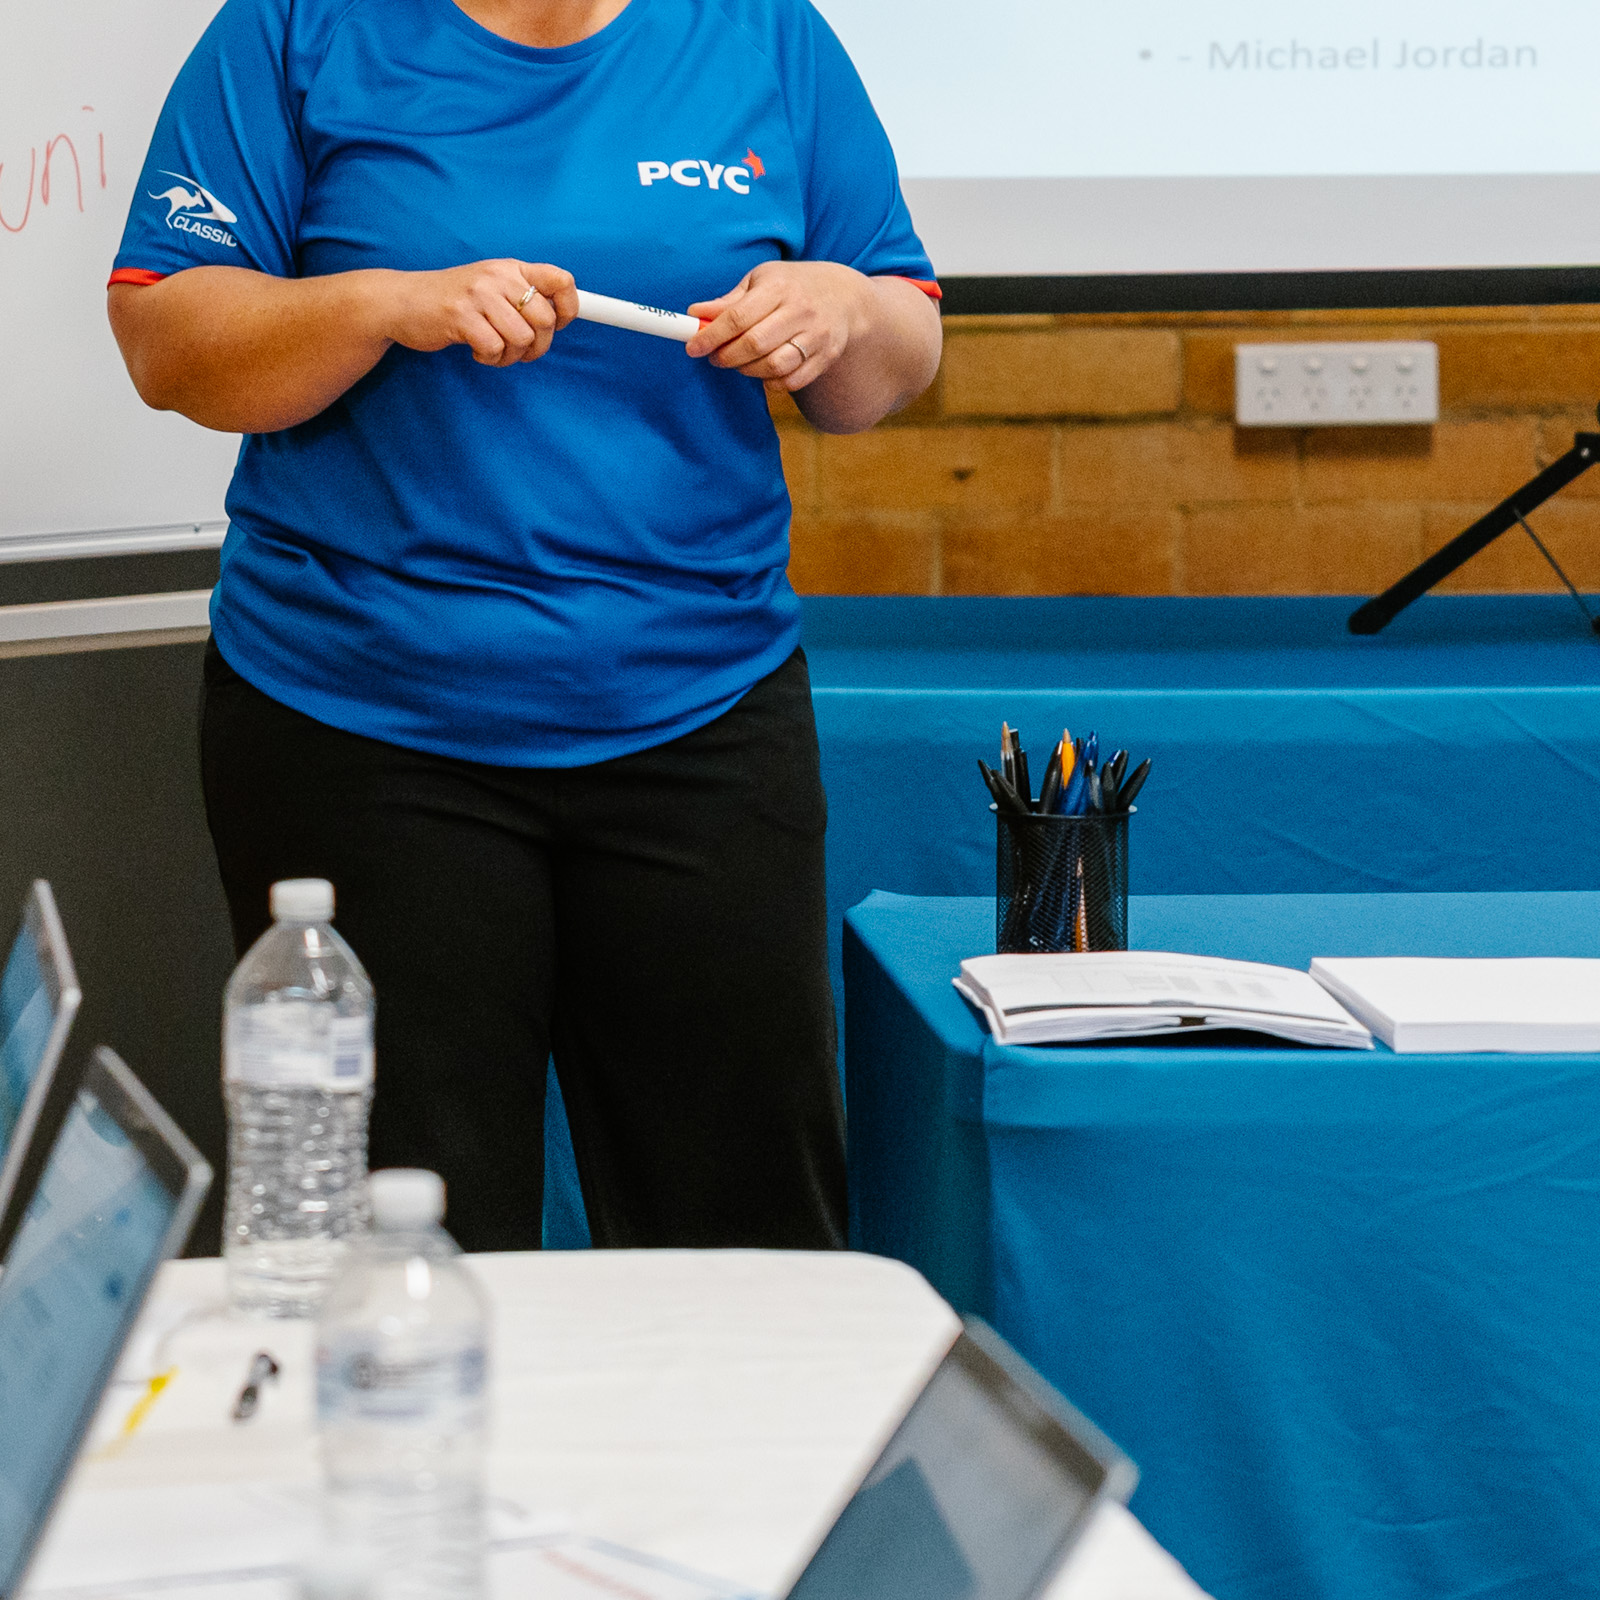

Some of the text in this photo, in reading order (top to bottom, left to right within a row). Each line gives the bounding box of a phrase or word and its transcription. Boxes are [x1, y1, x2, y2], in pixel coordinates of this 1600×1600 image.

[1207, 36, 1381, 71] Michael
[1393, 35, 1540, 71] Jordan
[637, 159, 751, 195] PCYC
[172, 215, 238, 248] CLASSIC
